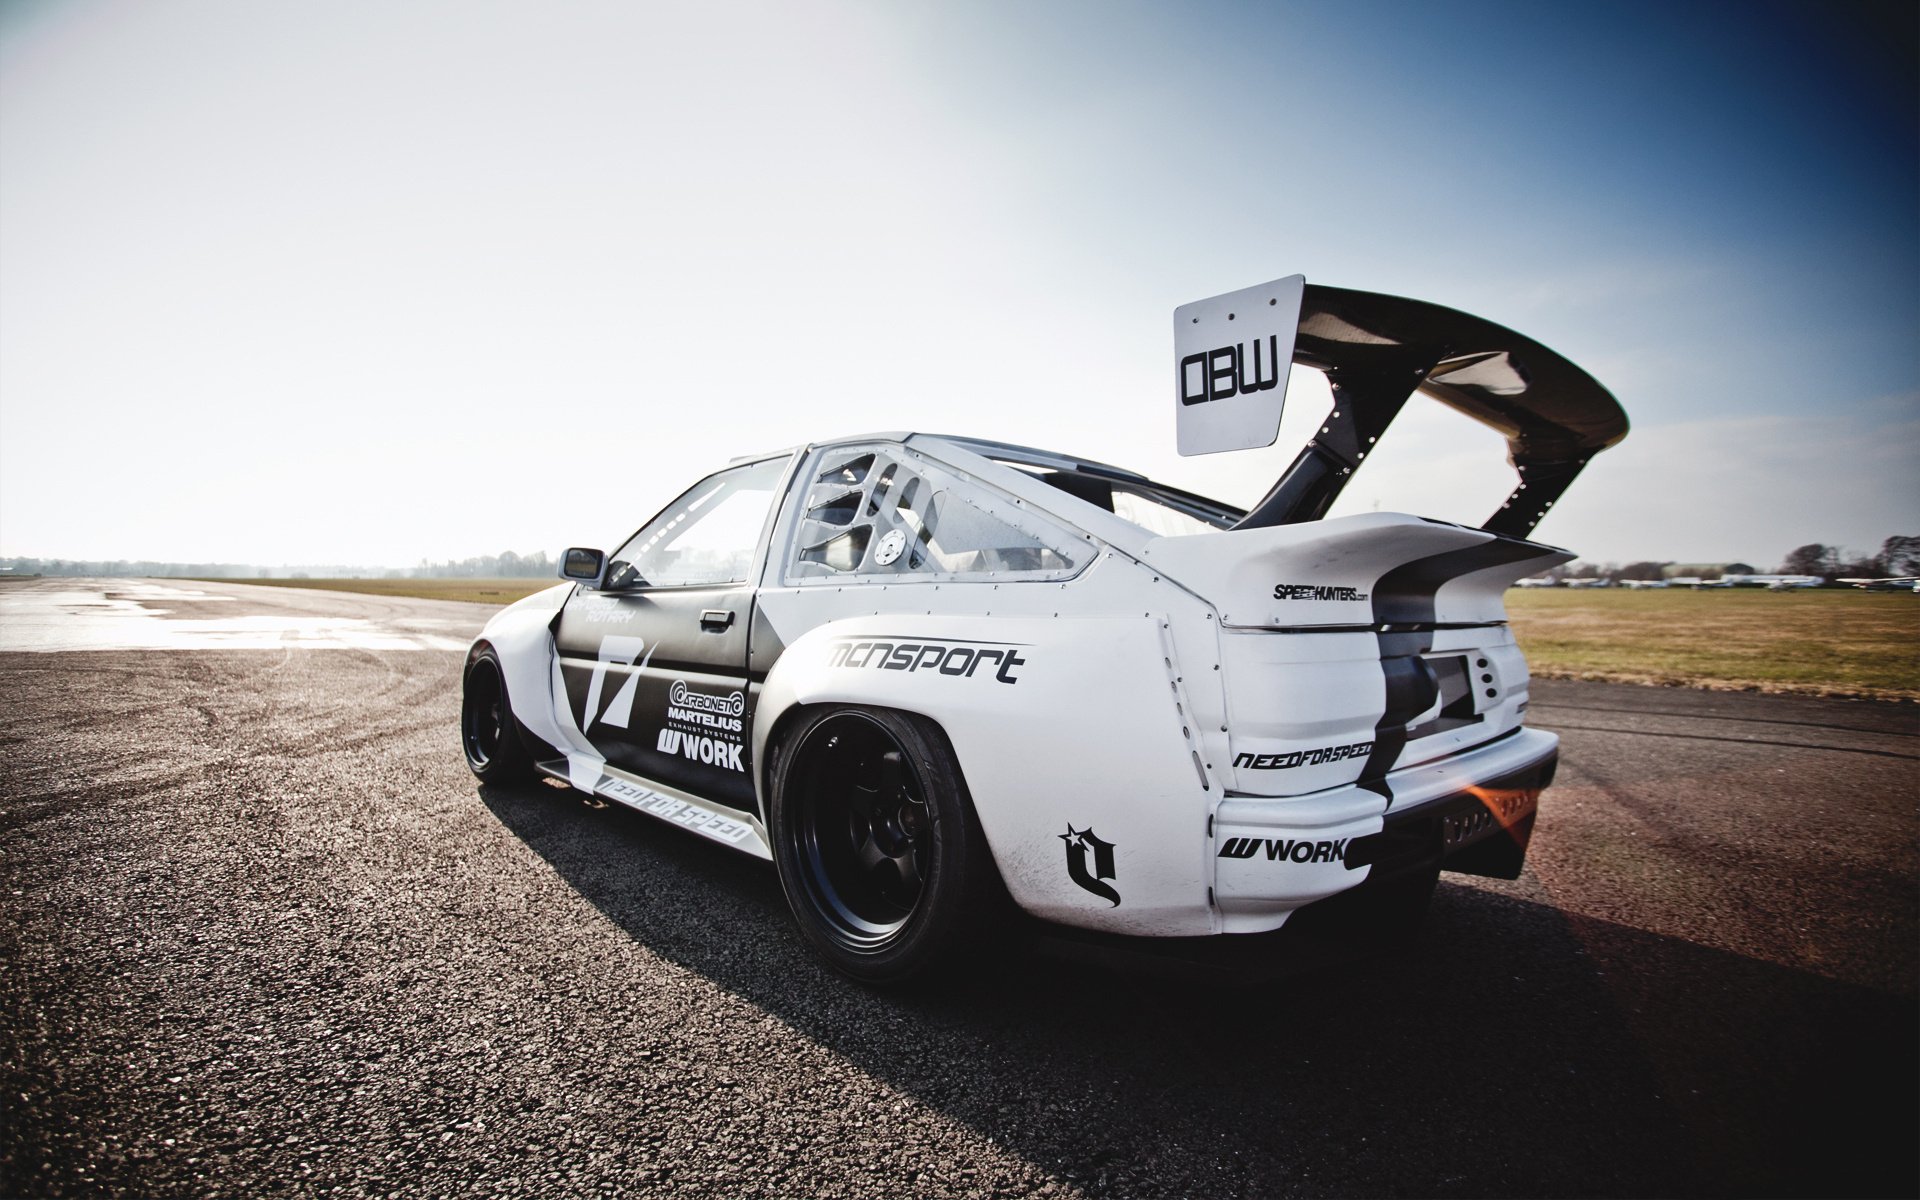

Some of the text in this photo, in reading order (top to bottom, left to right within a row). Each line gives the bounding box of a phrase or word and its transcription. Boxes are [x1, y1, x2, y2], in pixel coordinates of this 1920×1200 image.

[668, 706, 742, 732] MARTELIUS
[668, 721, 741, 742] EXHAUST SYSTEMS
[681, 732, 745, 772] WORK
